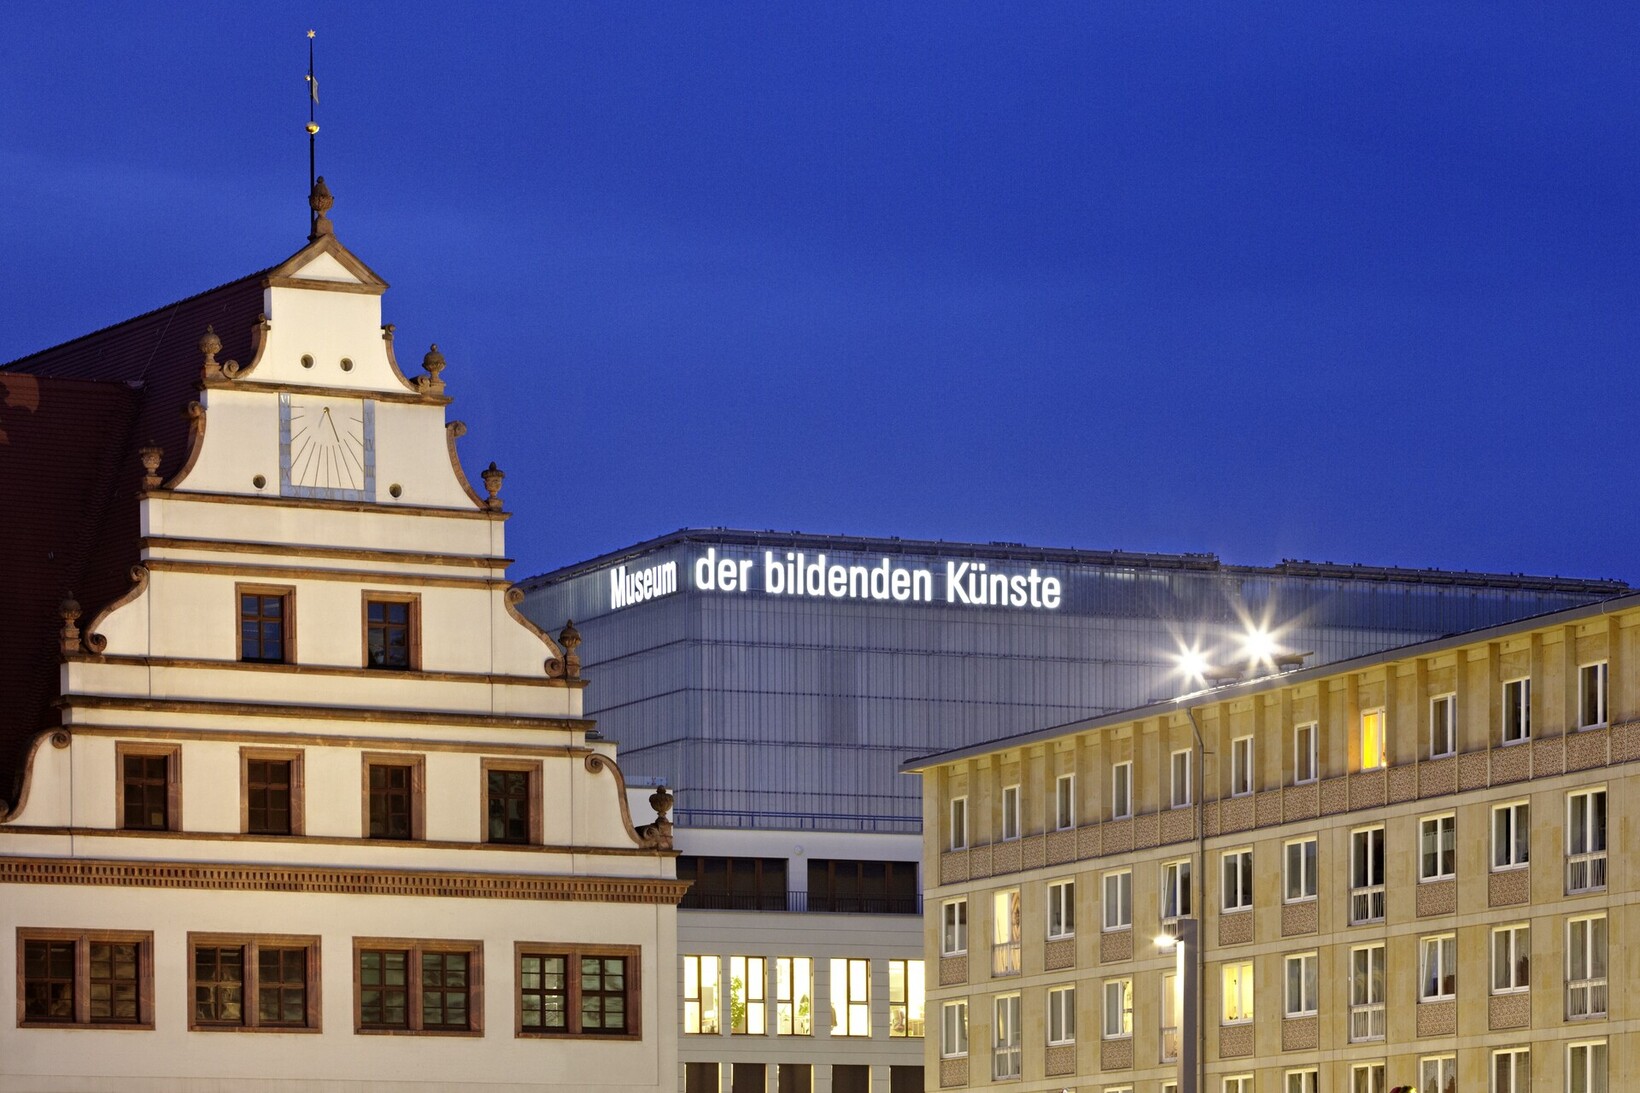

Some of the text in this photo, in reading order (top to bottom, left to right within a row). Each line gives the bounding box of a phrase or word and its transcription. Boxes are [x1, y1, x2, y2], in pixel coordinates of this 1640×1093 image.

[611, 561, 677, 609] Museum
[696, 547, 1061, 609] der bildenden Künste
